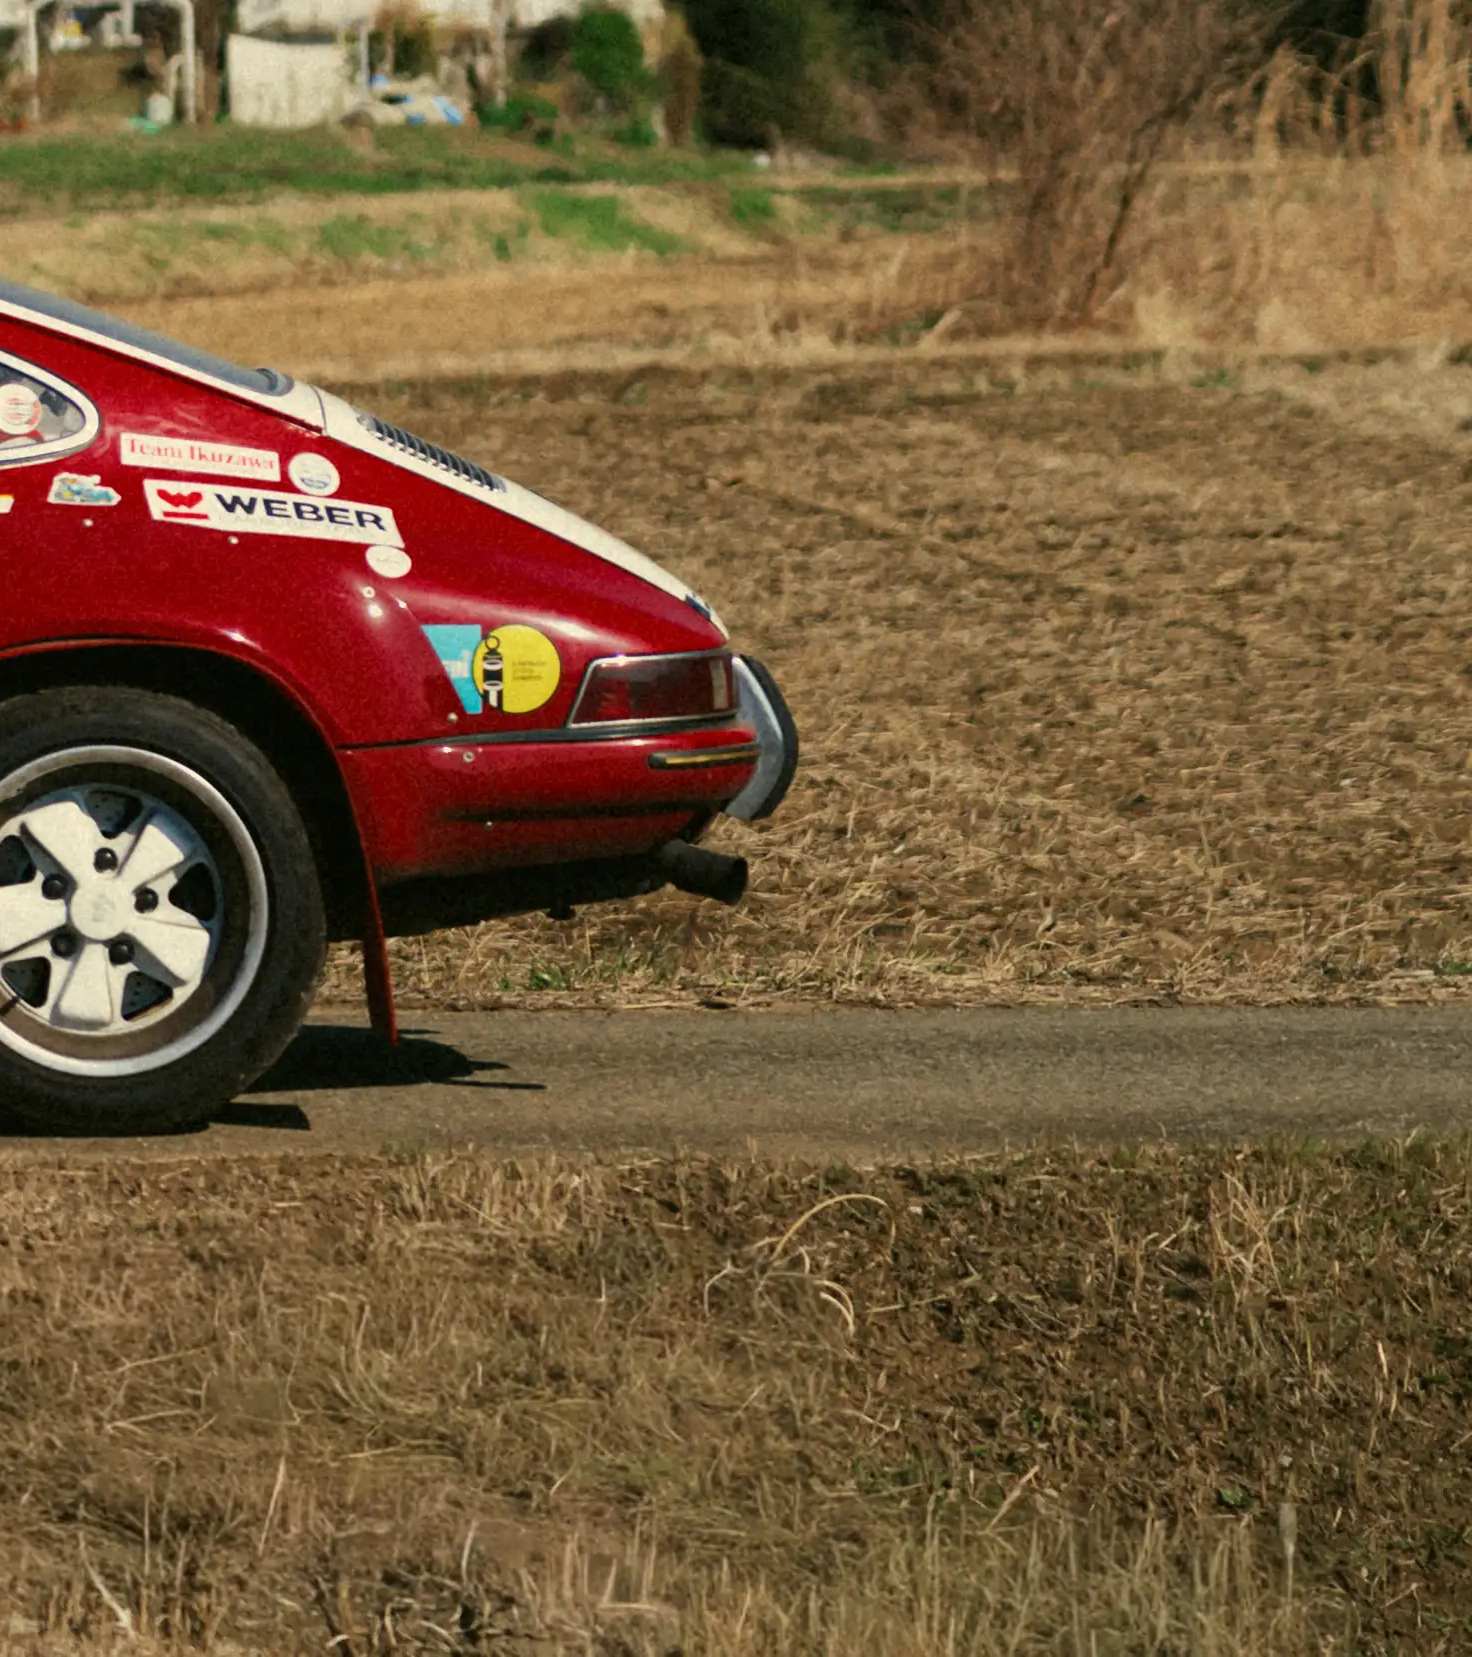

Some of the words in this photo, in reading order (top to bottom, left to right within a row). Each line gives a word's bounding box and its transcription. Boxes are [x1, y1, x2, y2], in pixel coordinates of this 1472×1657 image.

[126, 438, 183, 459] Team
[188, 444, 275, 471] Ikuzawa
[214, 493, 387, 532] WEBER
